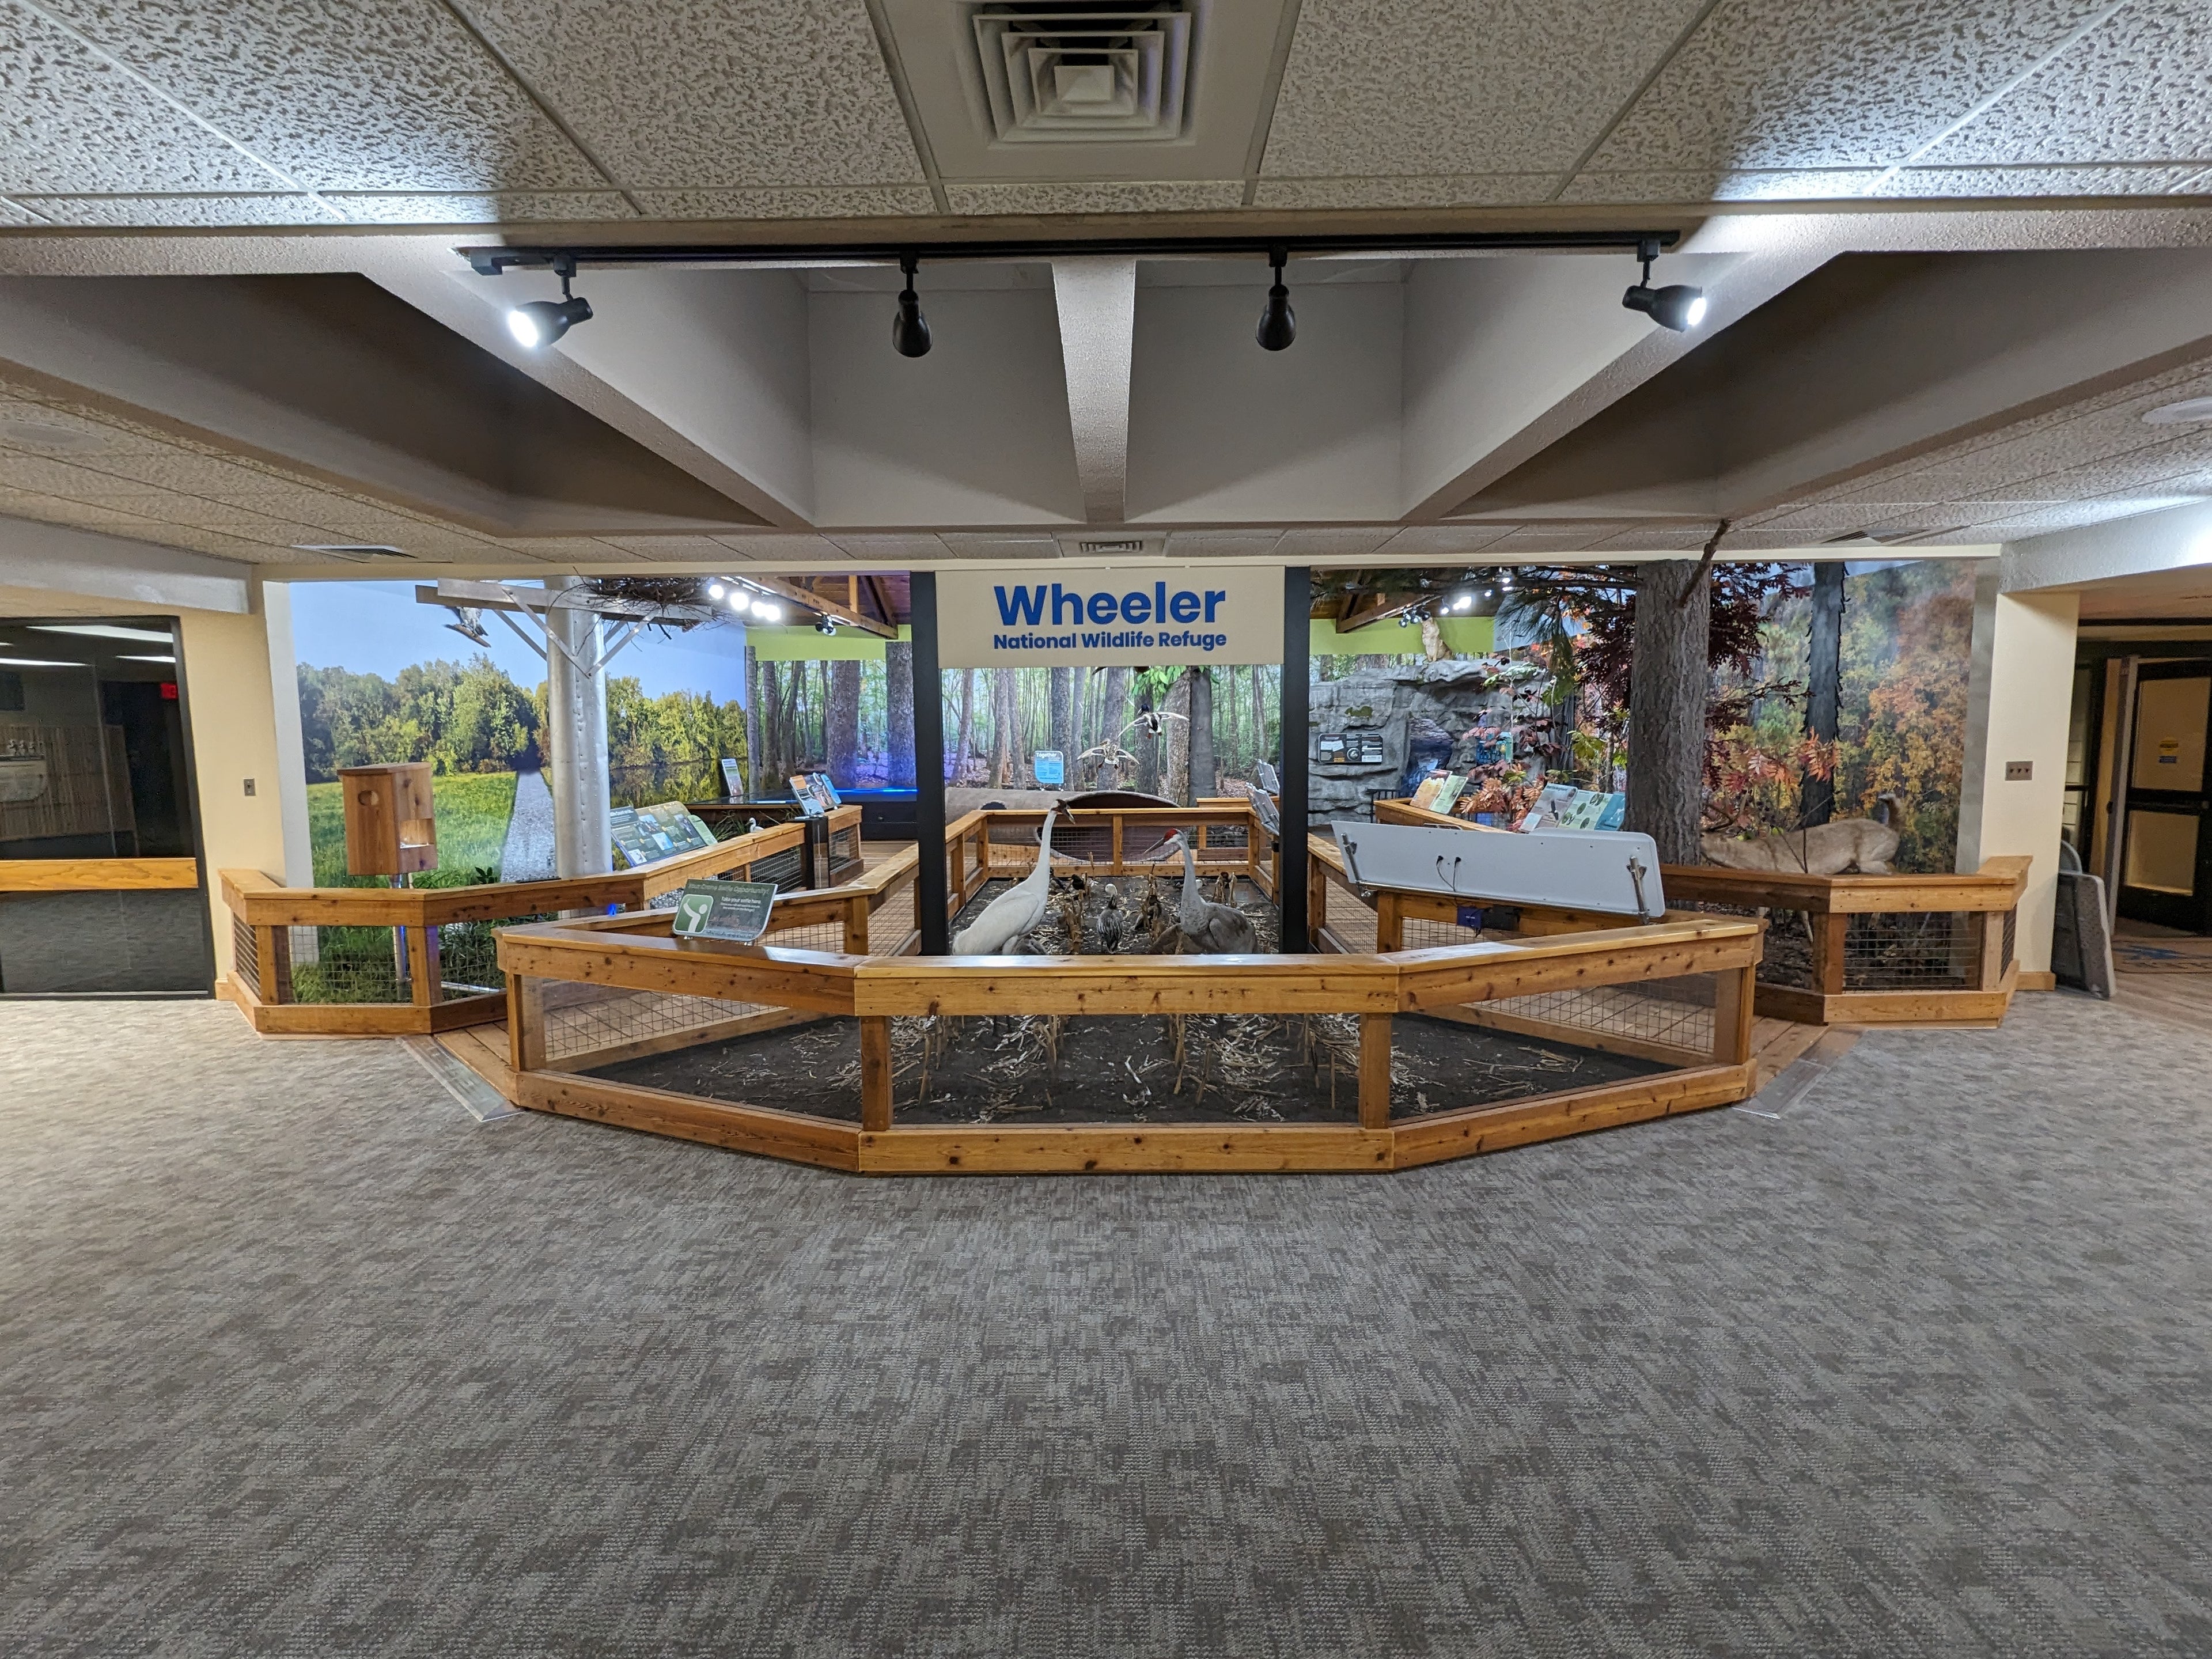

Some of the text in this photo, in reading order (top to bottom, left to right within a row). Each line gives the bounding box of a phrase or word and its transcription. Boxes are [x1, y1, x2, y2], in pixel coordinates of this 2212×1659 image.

[994, 582, 1226, 626] Wheeler
[994, 630, 1227, 652] National Wildlife Refuge
[734, 886, 770, 895] Opportunity!
